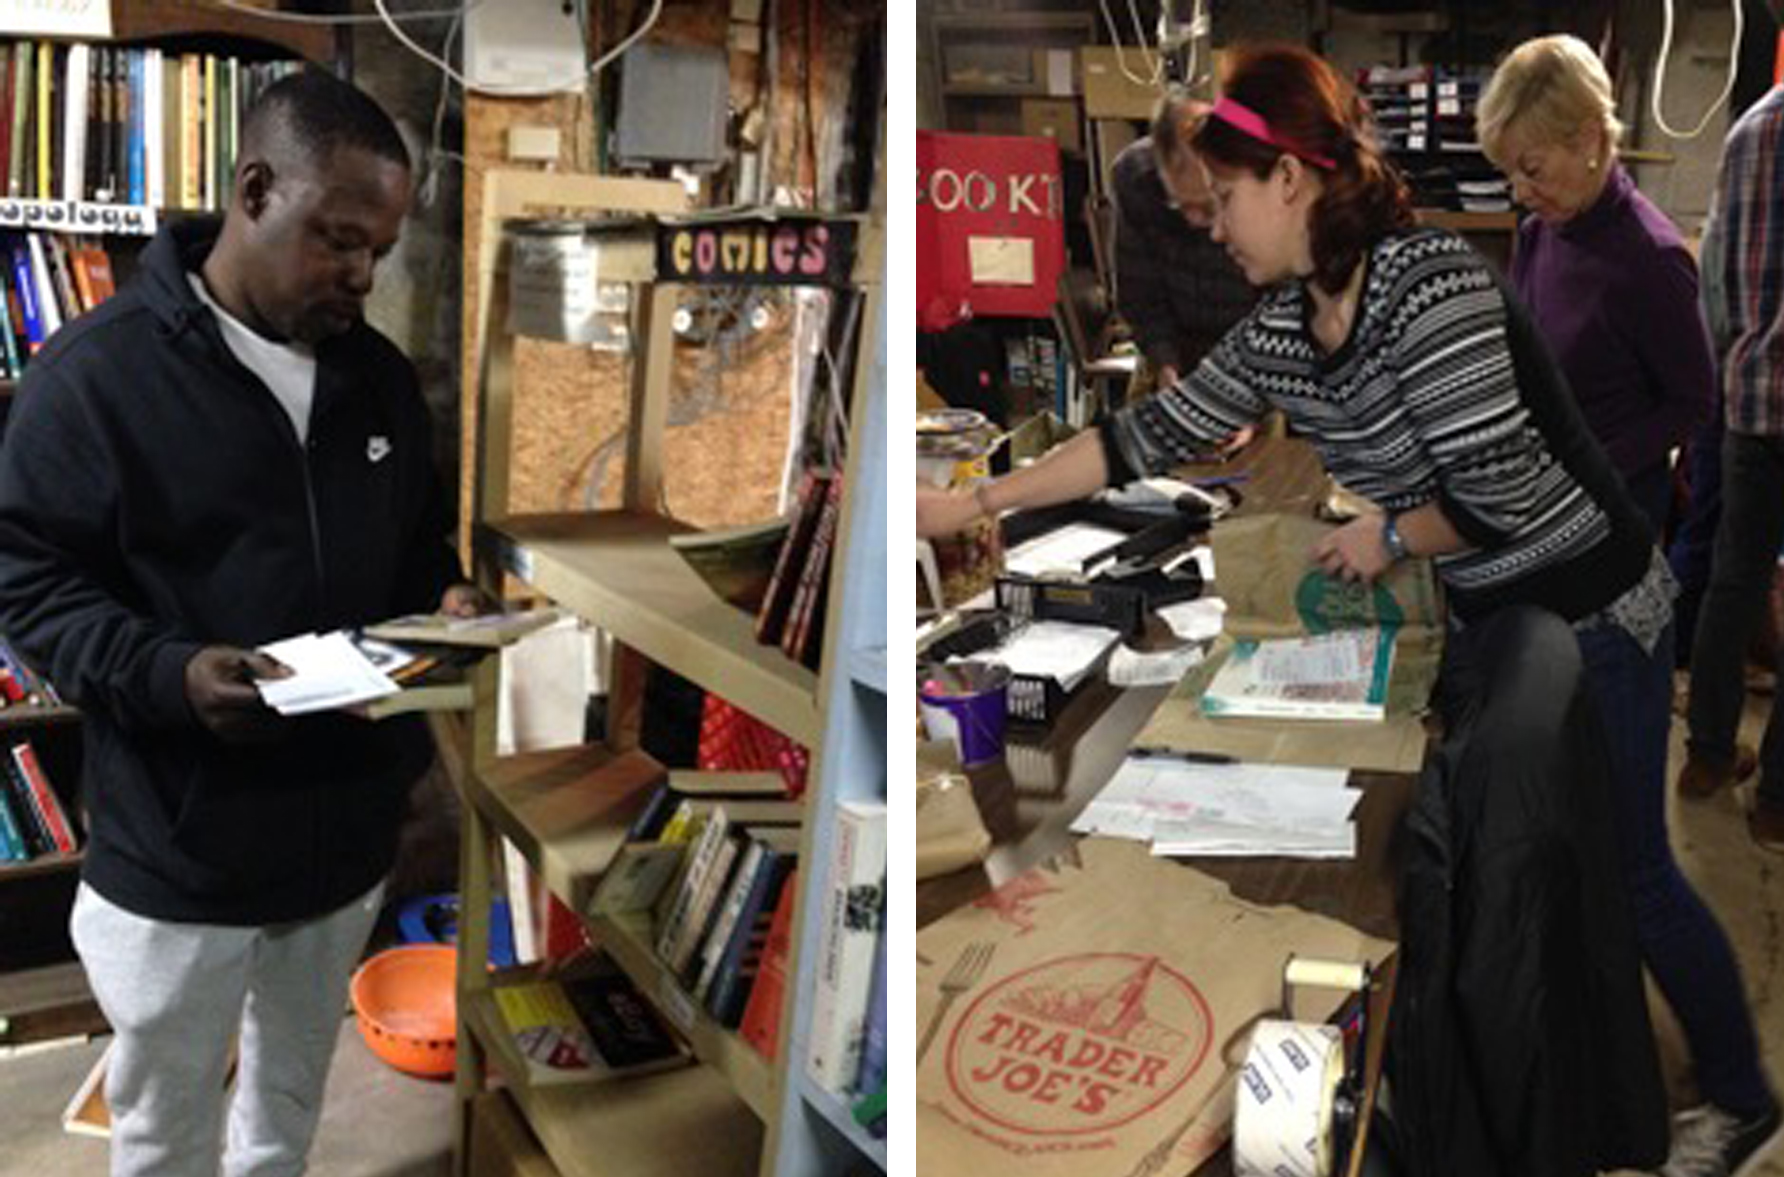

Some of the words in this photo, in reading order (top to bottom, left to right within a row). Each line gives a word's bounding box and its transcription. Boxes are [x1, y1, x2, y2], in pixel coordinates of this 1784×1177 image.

[672, 225, 829, 275] COMICS
[978, 1012, 1169, 1089] TRADER
[971, 1056, 1122, 1115] JOE'S
